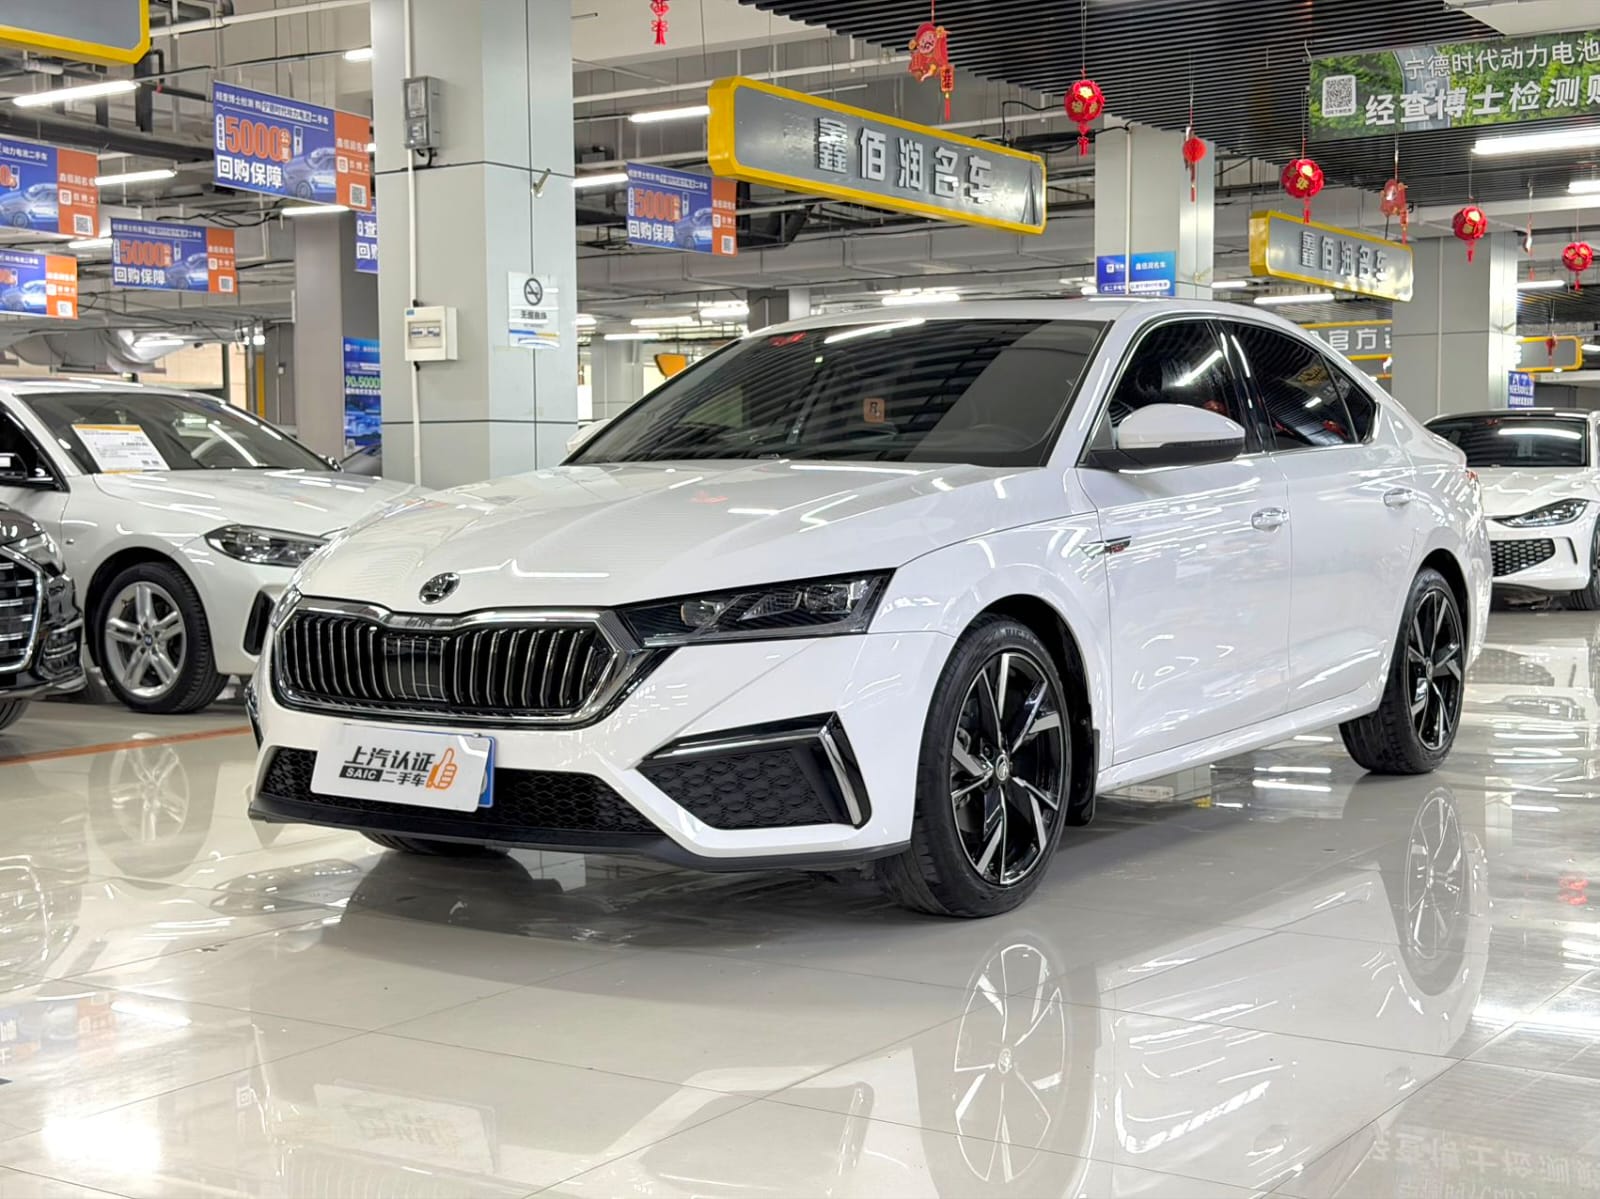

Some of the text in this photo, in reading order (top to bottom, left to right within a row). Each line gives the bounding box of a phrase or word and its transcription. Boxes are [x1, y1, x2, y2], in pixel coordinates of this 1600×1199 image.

[1405, 38, 1600, 80] 宁德时代动力电池
[225, 116, 282, 162] 5000
[216, 155, 283, 188] 回购保障
[816, 116, 993, 204] 鑫佰润名车
[627, 219, 675, 243] 回购保障
[114, 266, 166, 285] 回购保障
[344, 745, 435, 772] 上汽认证
[345, 767, 377, 780] SAIC
[381, 770, 425, 787] 二手车
